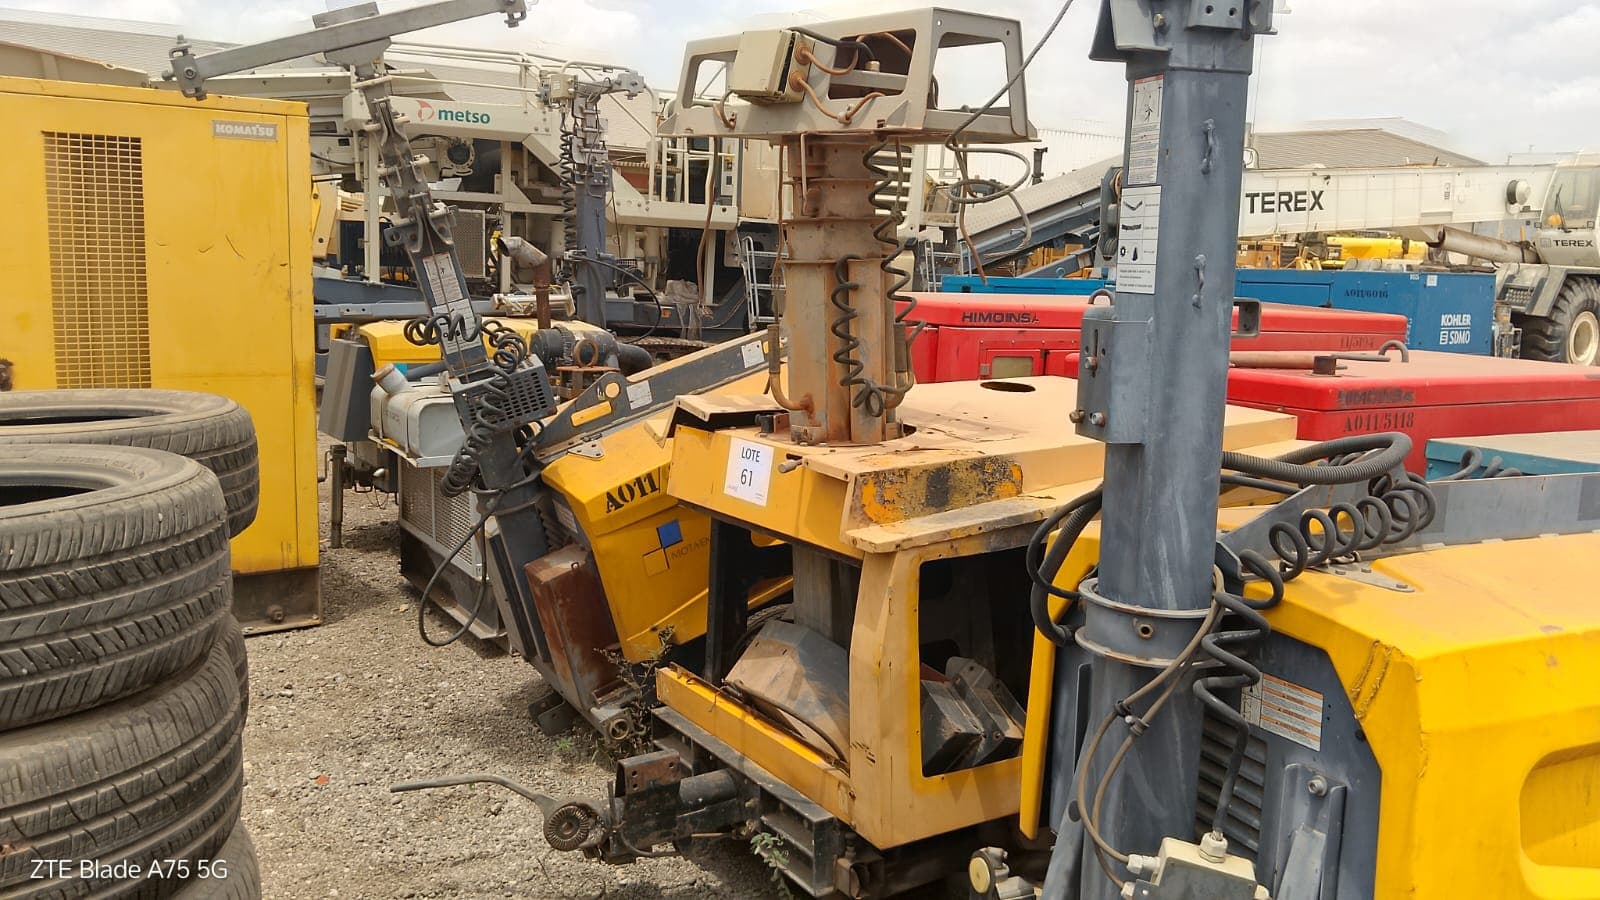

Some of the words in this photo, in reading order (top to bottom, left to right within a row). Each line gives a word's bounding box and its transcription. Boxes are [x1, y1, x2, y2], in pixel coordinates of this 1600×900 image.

[438, 109, 490, 124] metso
[215, 124, 274, 137] KOMATSU
[1245, 190, 1324, 214] TEREX
[1552, 239, 1594, 247] TEREX
[1441, 314, 1471, 327] KOHLER
[1449, 331, 1471, 345] SDMO
[741, 446, 761, 463] LOTE
[740, 468, 753, 487] 61
